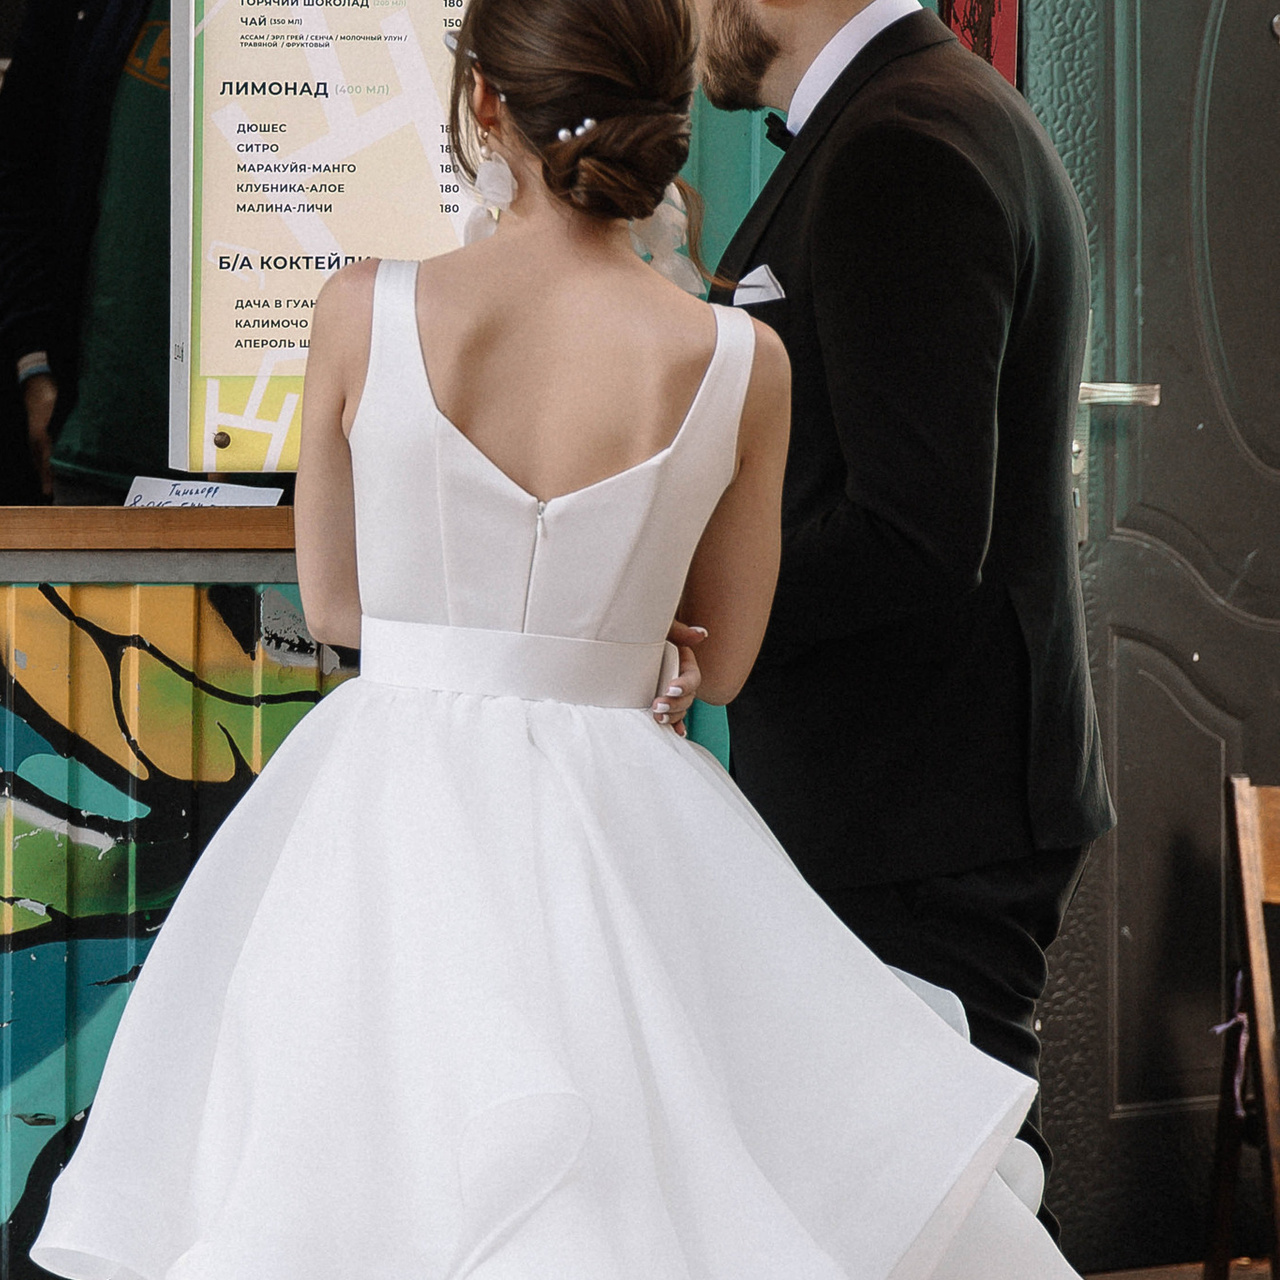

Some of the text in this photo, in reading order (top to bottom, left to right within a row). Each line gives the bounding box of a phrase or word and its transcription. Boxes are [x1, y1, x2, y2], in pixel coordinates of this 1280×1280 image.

[240, 16, 267, 27] ЧАЙ
[269, 17, 286, 26] (350
[443, 18, 463, 28] 150
[220, 82, 328, 98] ЛИМОНАД
[334, 83, 363, 97] (400
[236, 123, 287, 134] ДЮШЕС
[236, 143, 279, 153] СИТРО
[236, 161, 357, 173] МАРАКУЙЯ-МАНГО
[236, 183, 460, 194] КЛУБНИКА-АЛОЕ 180
[236, 203, 460, 214] МАЛИНА-ЛИЧИ 180
[219, 253, 371, 271] Б/А КОКТЕЙЛ
[234, 299, 271, 310] ДАЧА
[274, 299, 283, 309] В
[235, 319, 309, 329] КАЛИМОЧО
[234, 339, 296, 349] АПЕРОЛЬ
